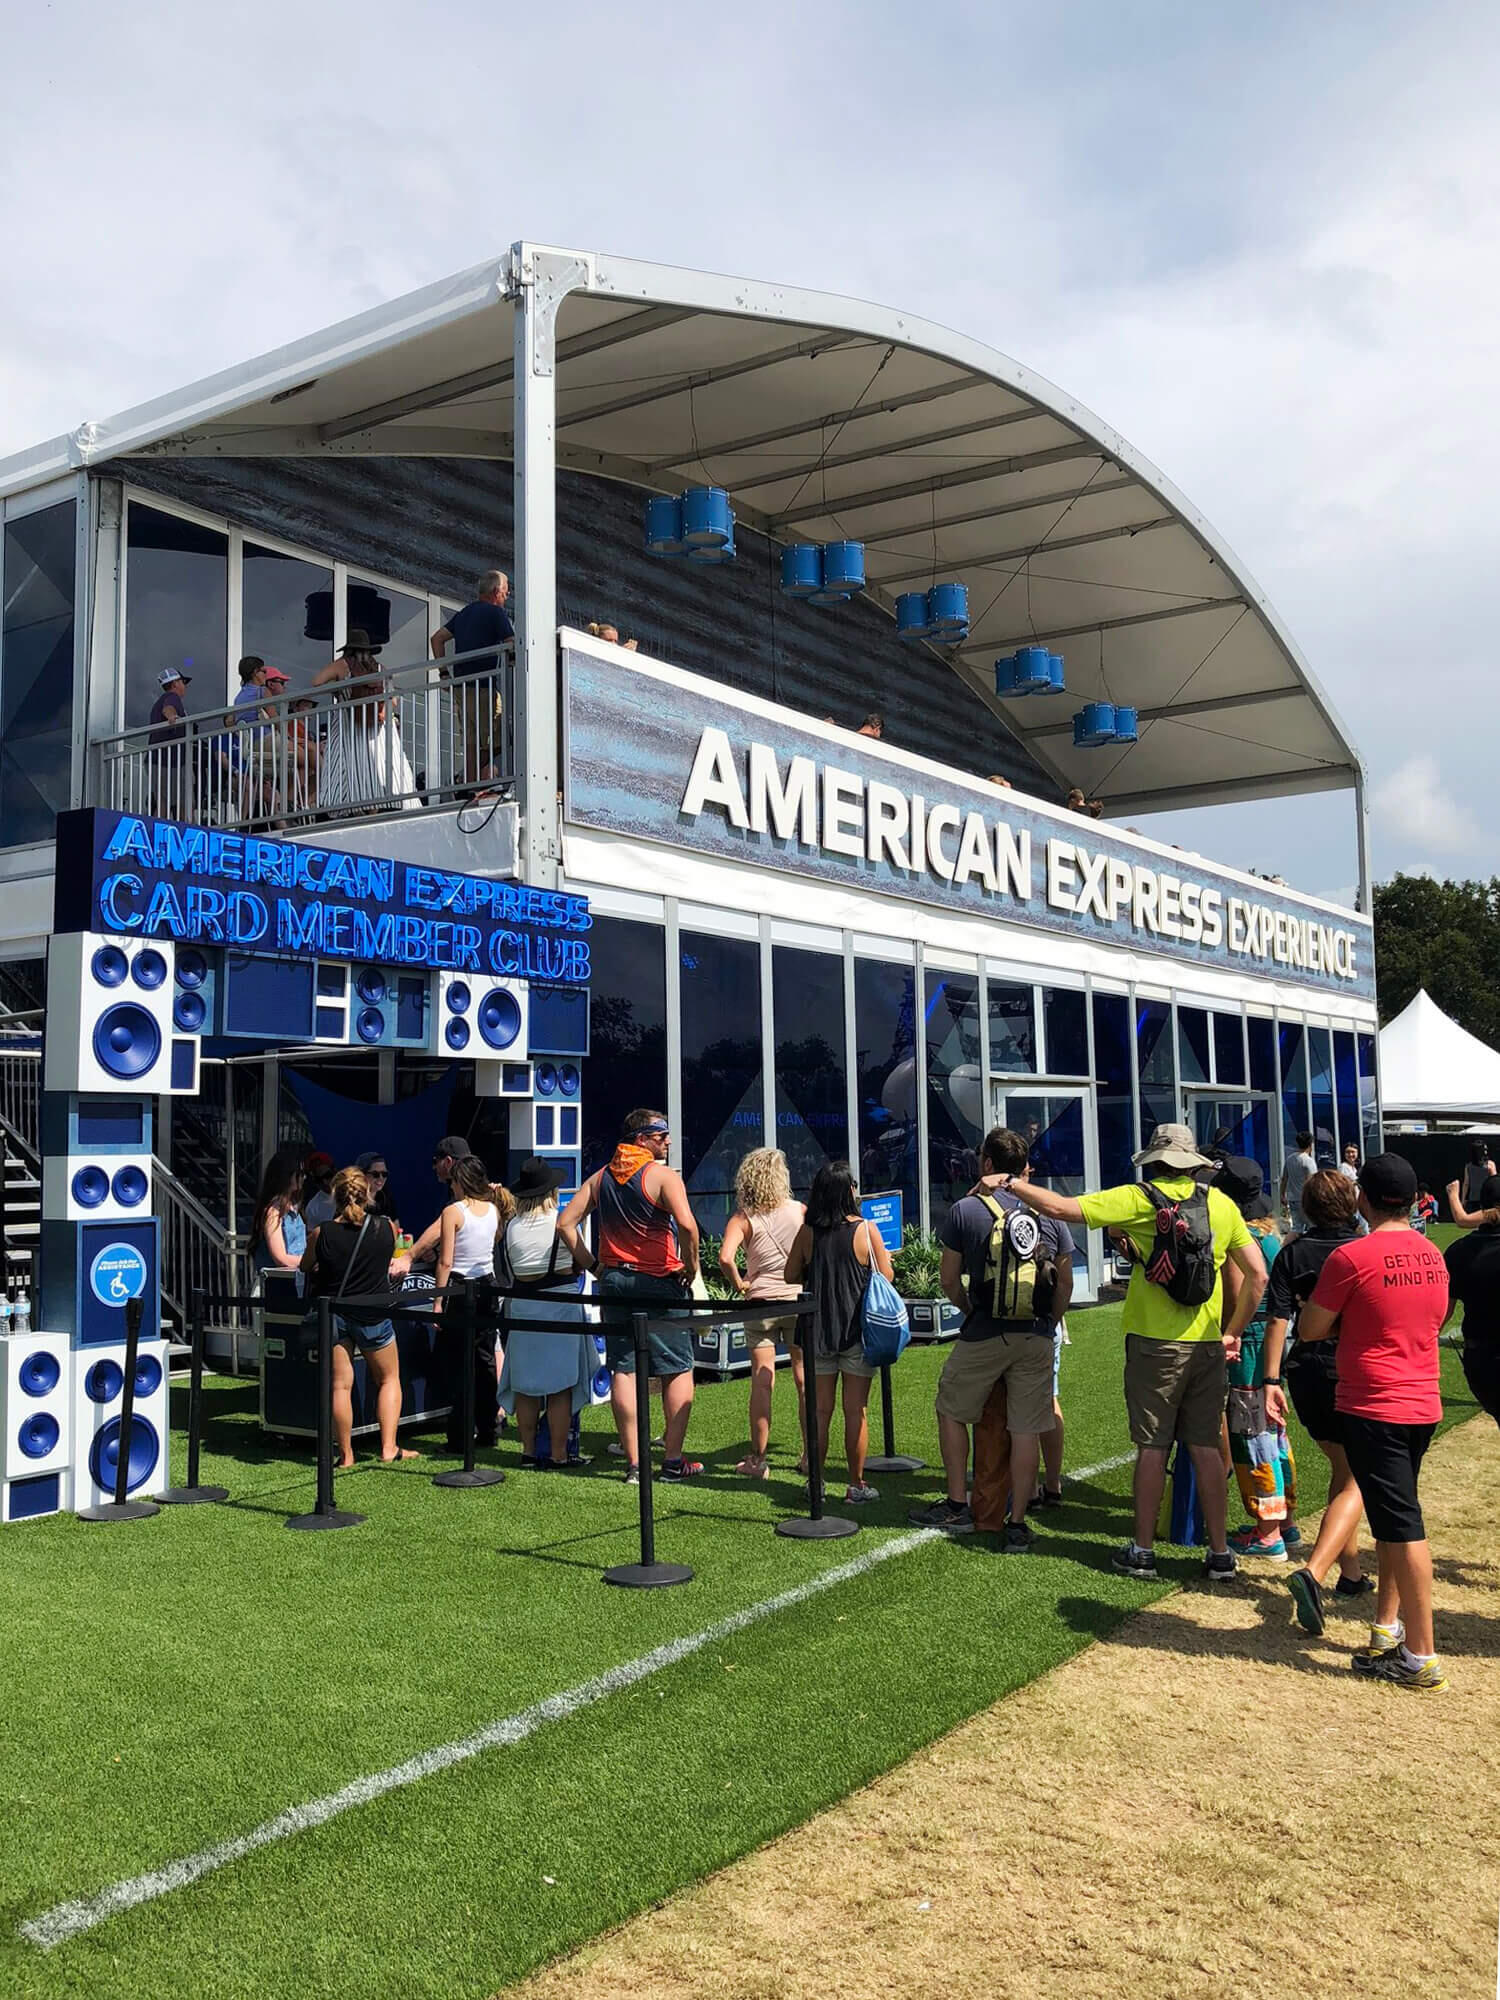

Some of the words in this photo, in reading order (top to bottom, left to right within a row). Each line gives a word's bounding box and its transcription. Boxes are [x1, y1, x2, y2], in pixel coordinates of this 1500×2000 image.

[102, 815, 395, 902] AMERICAN
[405, 866, 593, 932] EXPRESS
[680, 726, 1032, 900] AMERICAN
[1048, 838, 1222, 947] EXPRESS
[1227, 896, 1358, 979] EXPERIENCE
[100, 873, 269, 944] CARD
[277, 898, 482, 970] MEMBER
[488, 929, 592, 982] CLUB
[732, 1111, 804, 1127] AMECAN
[1384, 1254, 1411, 1269] GET
[1384, 1271, 1422, 1288] MIND
